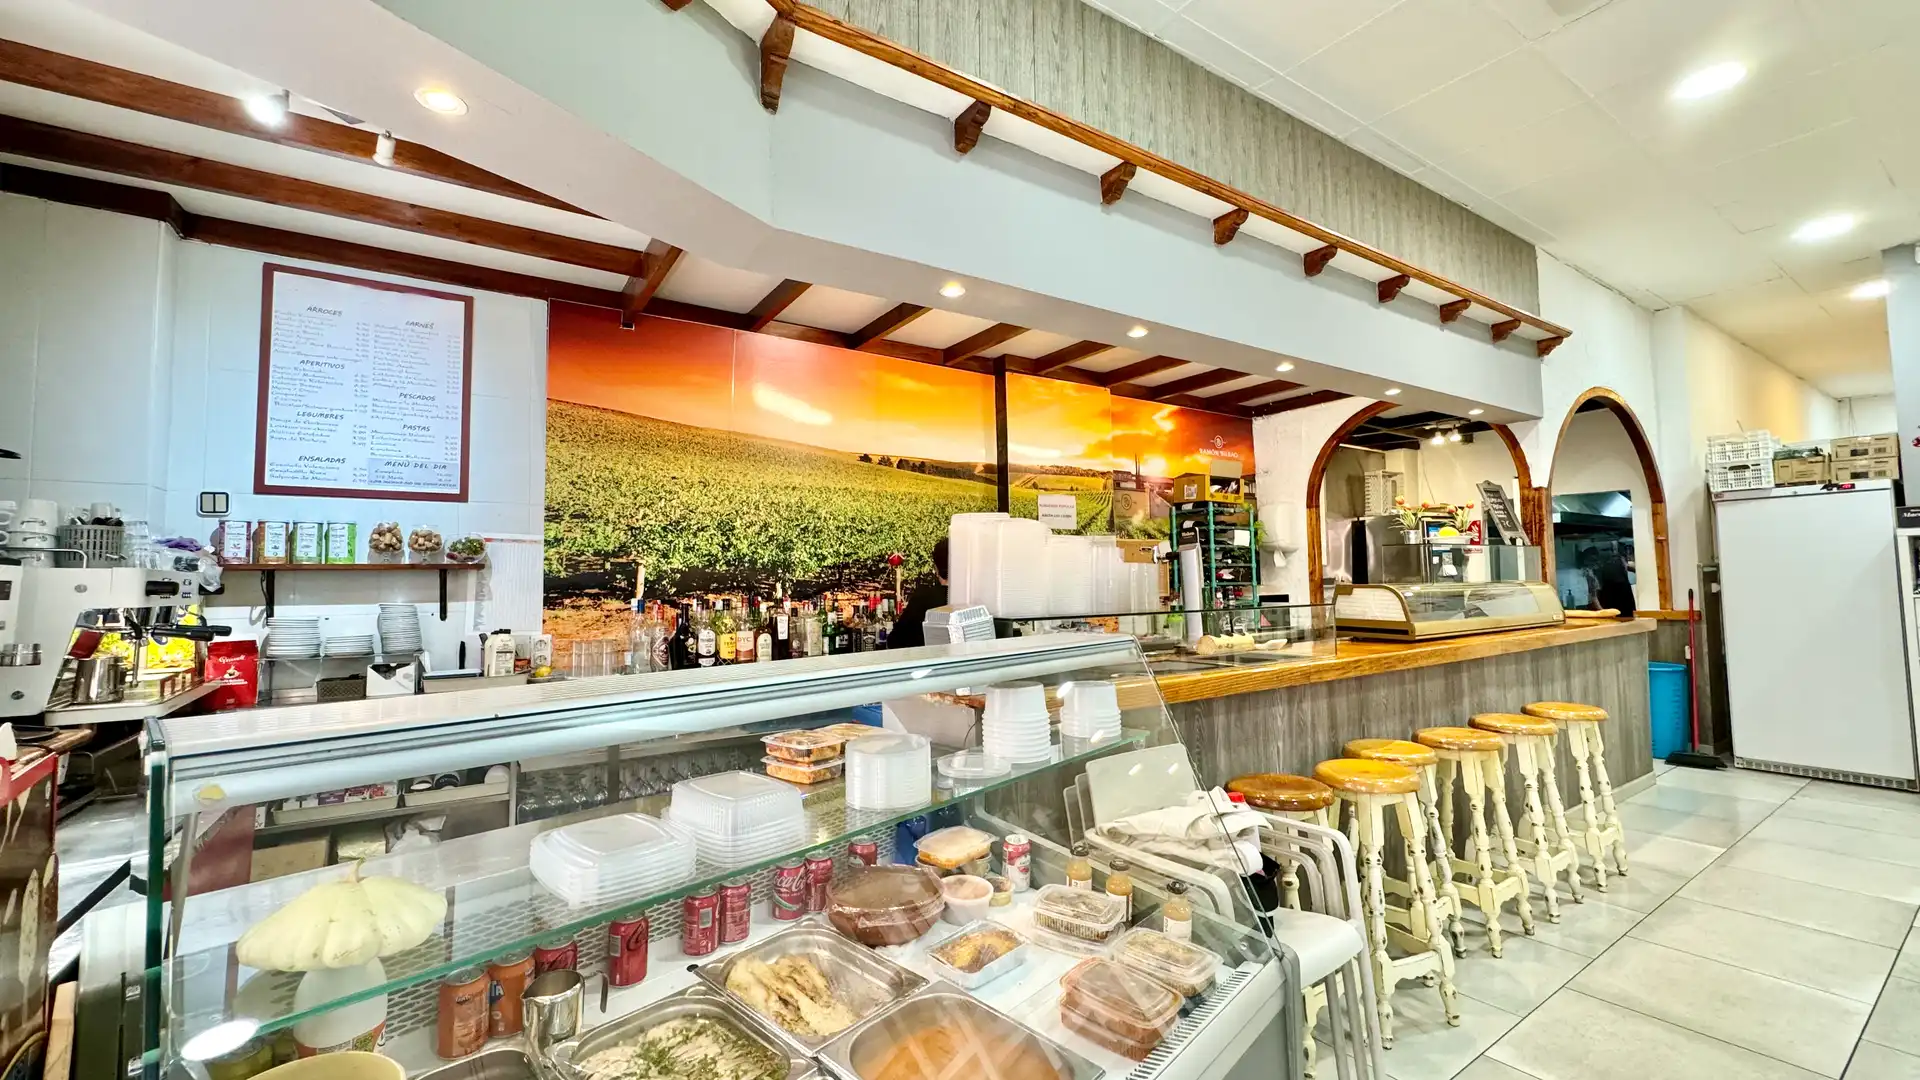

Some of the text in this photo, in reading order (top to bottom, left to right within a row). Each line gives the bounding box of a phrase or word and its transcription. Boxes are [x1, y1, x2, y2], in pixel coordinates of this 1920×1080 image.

[307, 306, 343, 317] ARROCES
[405, 320, 435, 330] CARNES
[300, 359, 345, 370] APERITIVOS
[399, 392, 436, 401] PESCADOS
[297, 411, 344, 420] LEGUMBRES
[402, 424, 431, 432] PASTAS
[298, 455, 346, 464] ENSALADAS
[413, 461, 429, 469] DEL
